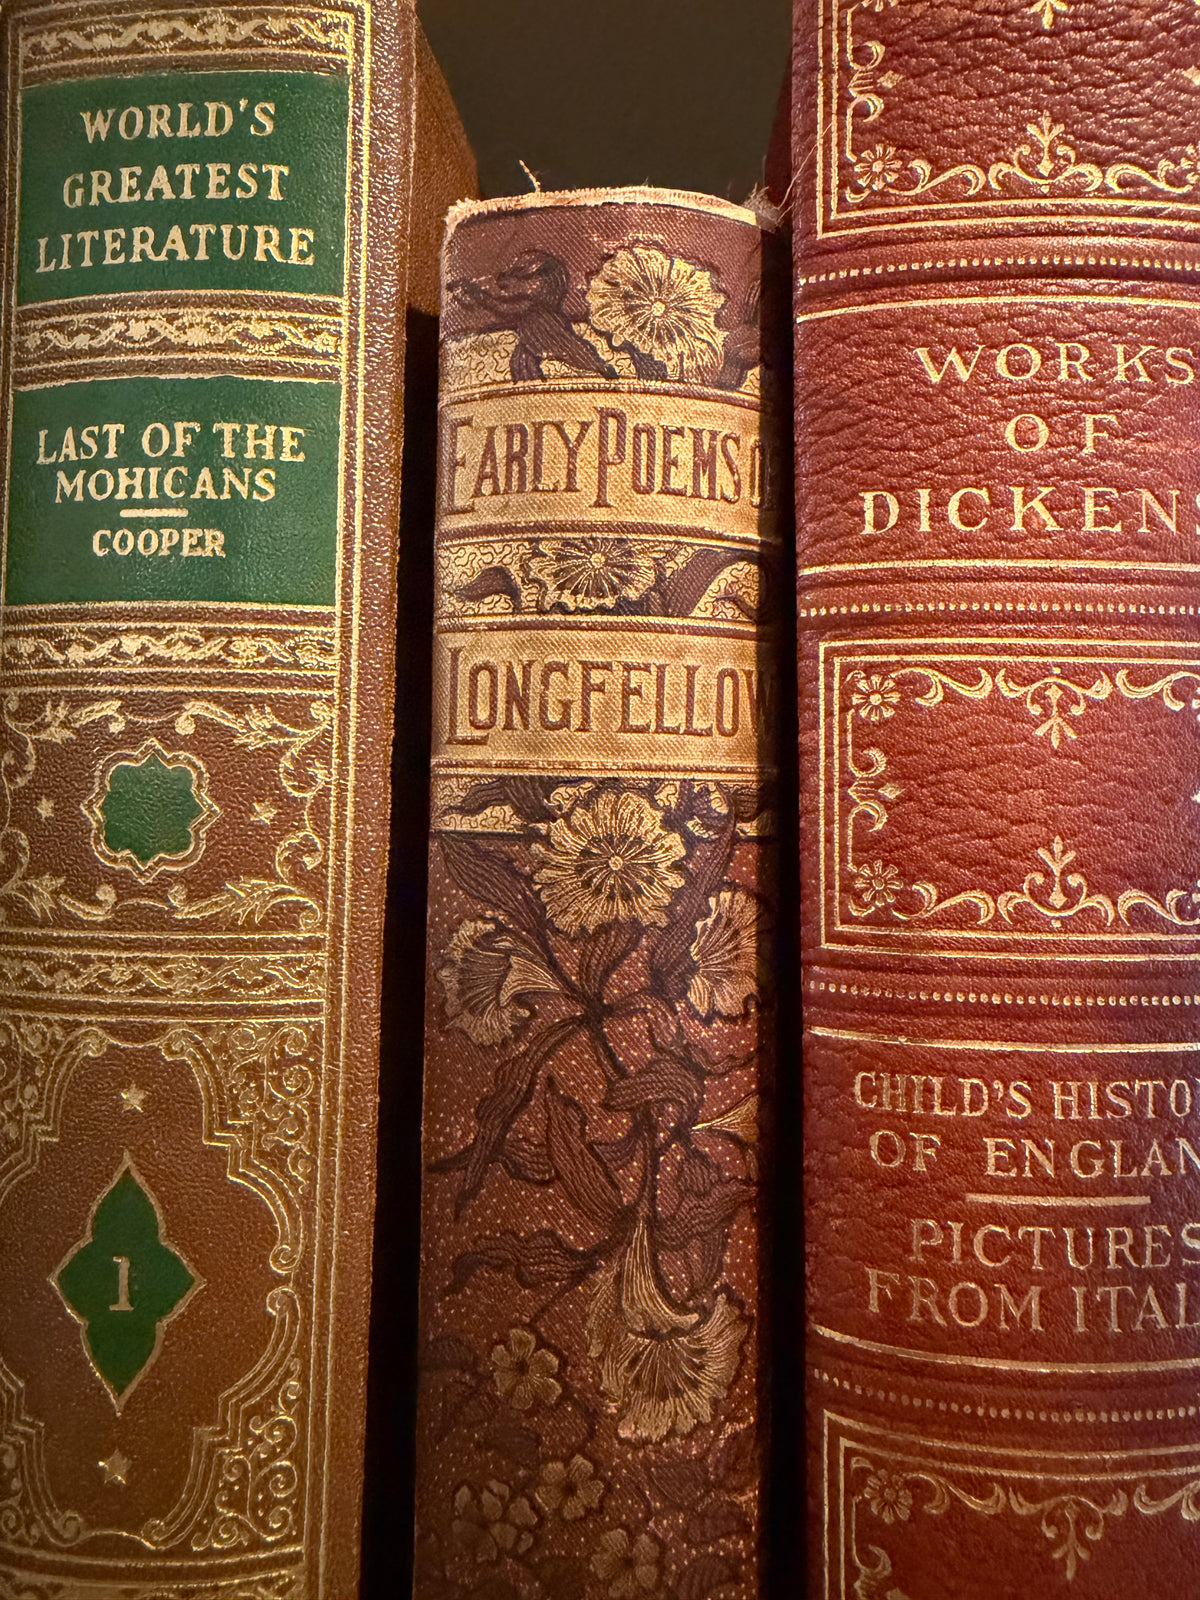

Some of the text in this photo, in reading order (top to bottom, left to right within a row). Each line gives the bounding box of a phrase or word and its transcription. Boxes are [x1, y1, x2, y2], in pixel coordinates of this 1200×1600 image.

[81, 98, 276, 143] WORLD'S
[63, 162, 290, 208] GREATEST
[36, 224, 314, 273] LITERATURE
[914, 341, 1195, 385] WORKS
[37, 421, 306, 465] LAST OF THE
[1005, 413, 1120, 454] OF
[55, 466, 277, 503] MOHICANS
[444, 415, 593, 517] EARLY
[589, 406, 742, 508] POEMS
[858, 486, 1200, 535] DICKEN
[92, 528, 226, 558] COOPER
[853, 1071, 1200, 1120] CHILD'S HISTO
[869, 1130, 941, 1172] OF
[908, 1217, 1200, 1271] PICTURES
[109, 1256, 134, 1311] 1
[864, 1267, 1045, 1332] FROM
